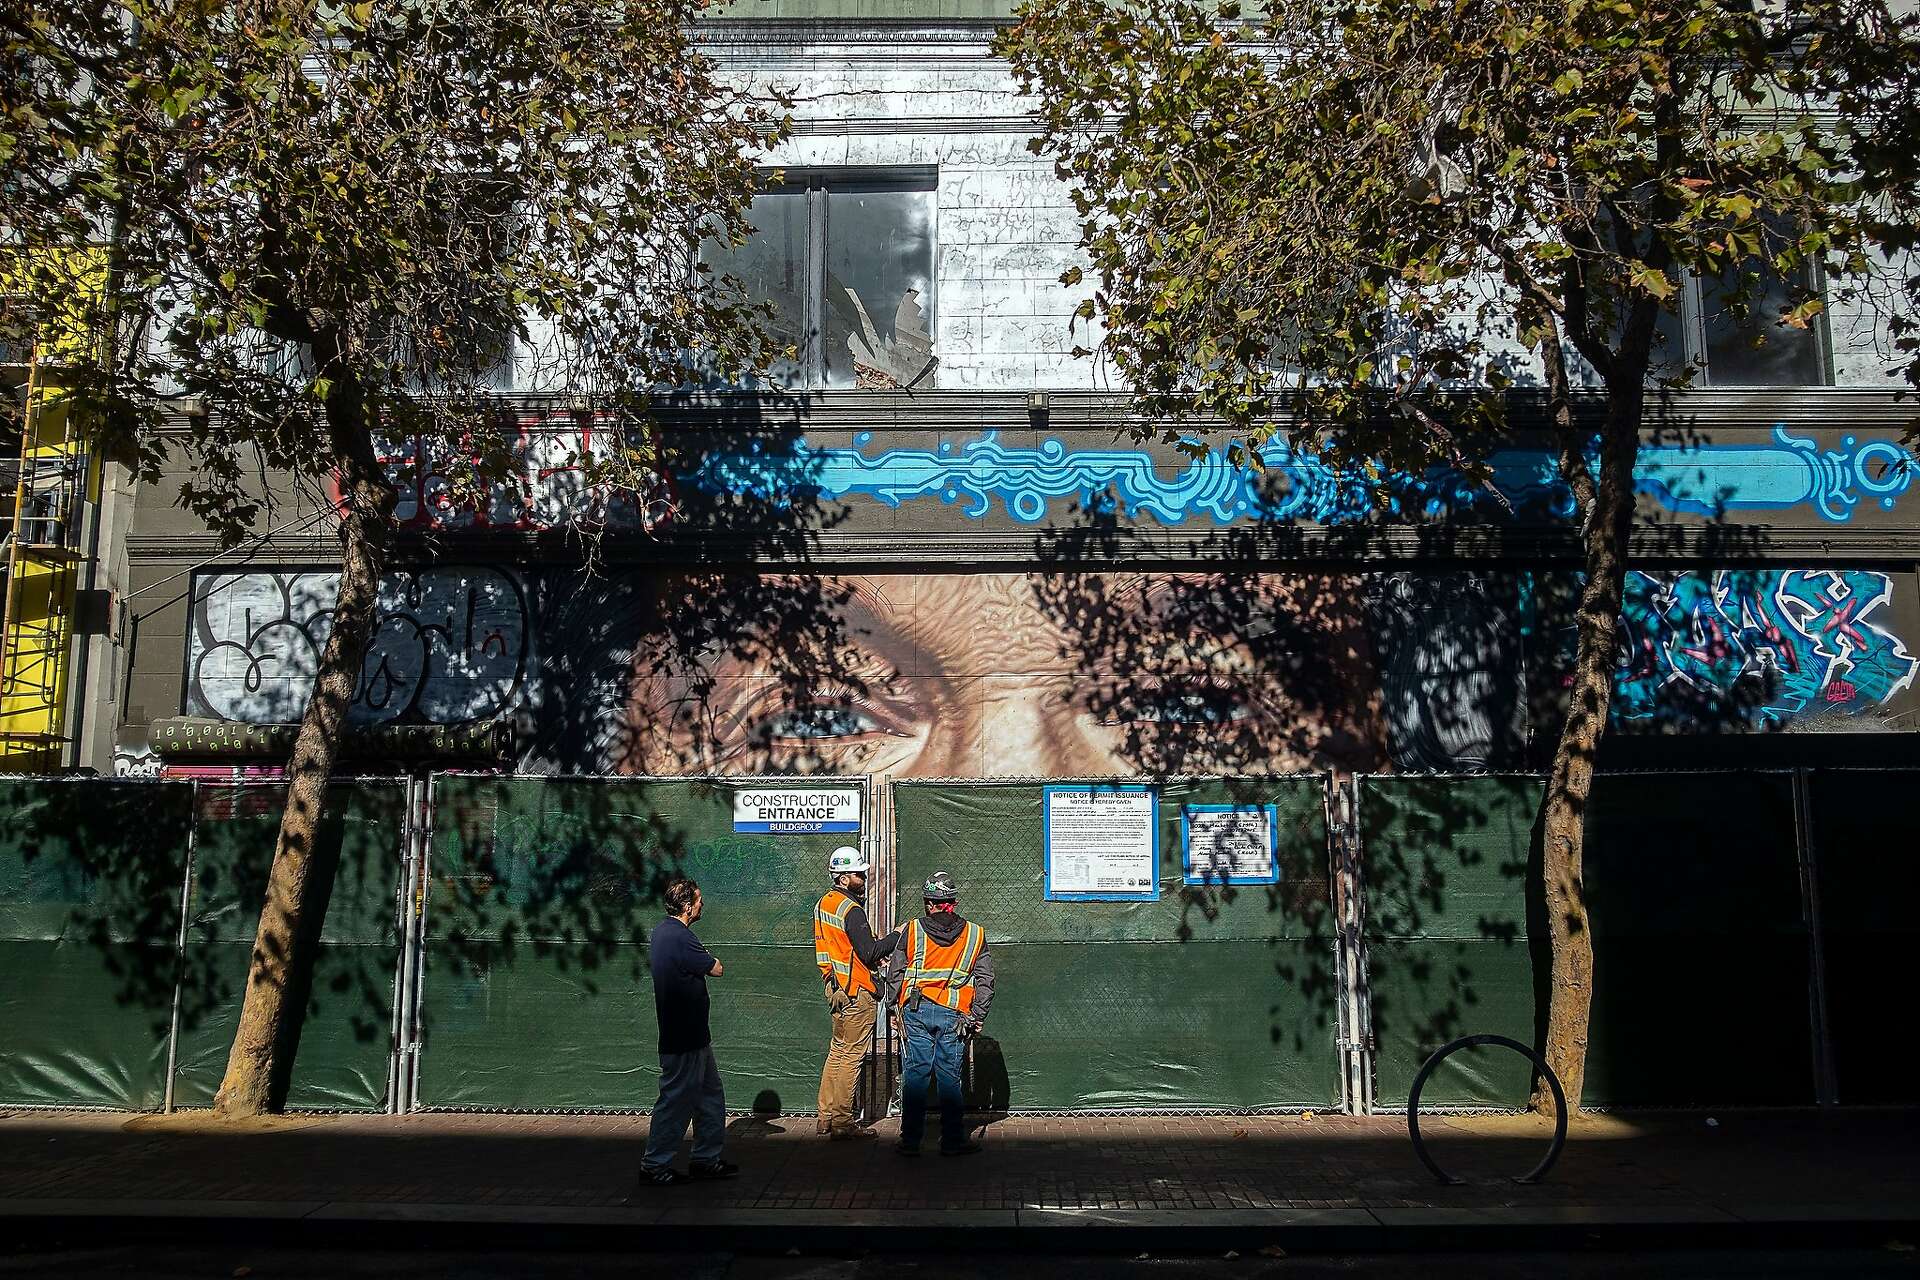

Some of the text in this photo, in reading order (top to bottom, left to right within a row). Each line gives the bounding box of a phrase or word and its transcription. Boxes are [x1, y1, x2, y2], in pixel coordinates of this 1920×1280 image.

[743, 794, 850, 807] CONSTRUCTION
[758, 808, 835, 819] ENTRANCE
[769, 823, 823, 831] BUILDGROUP
